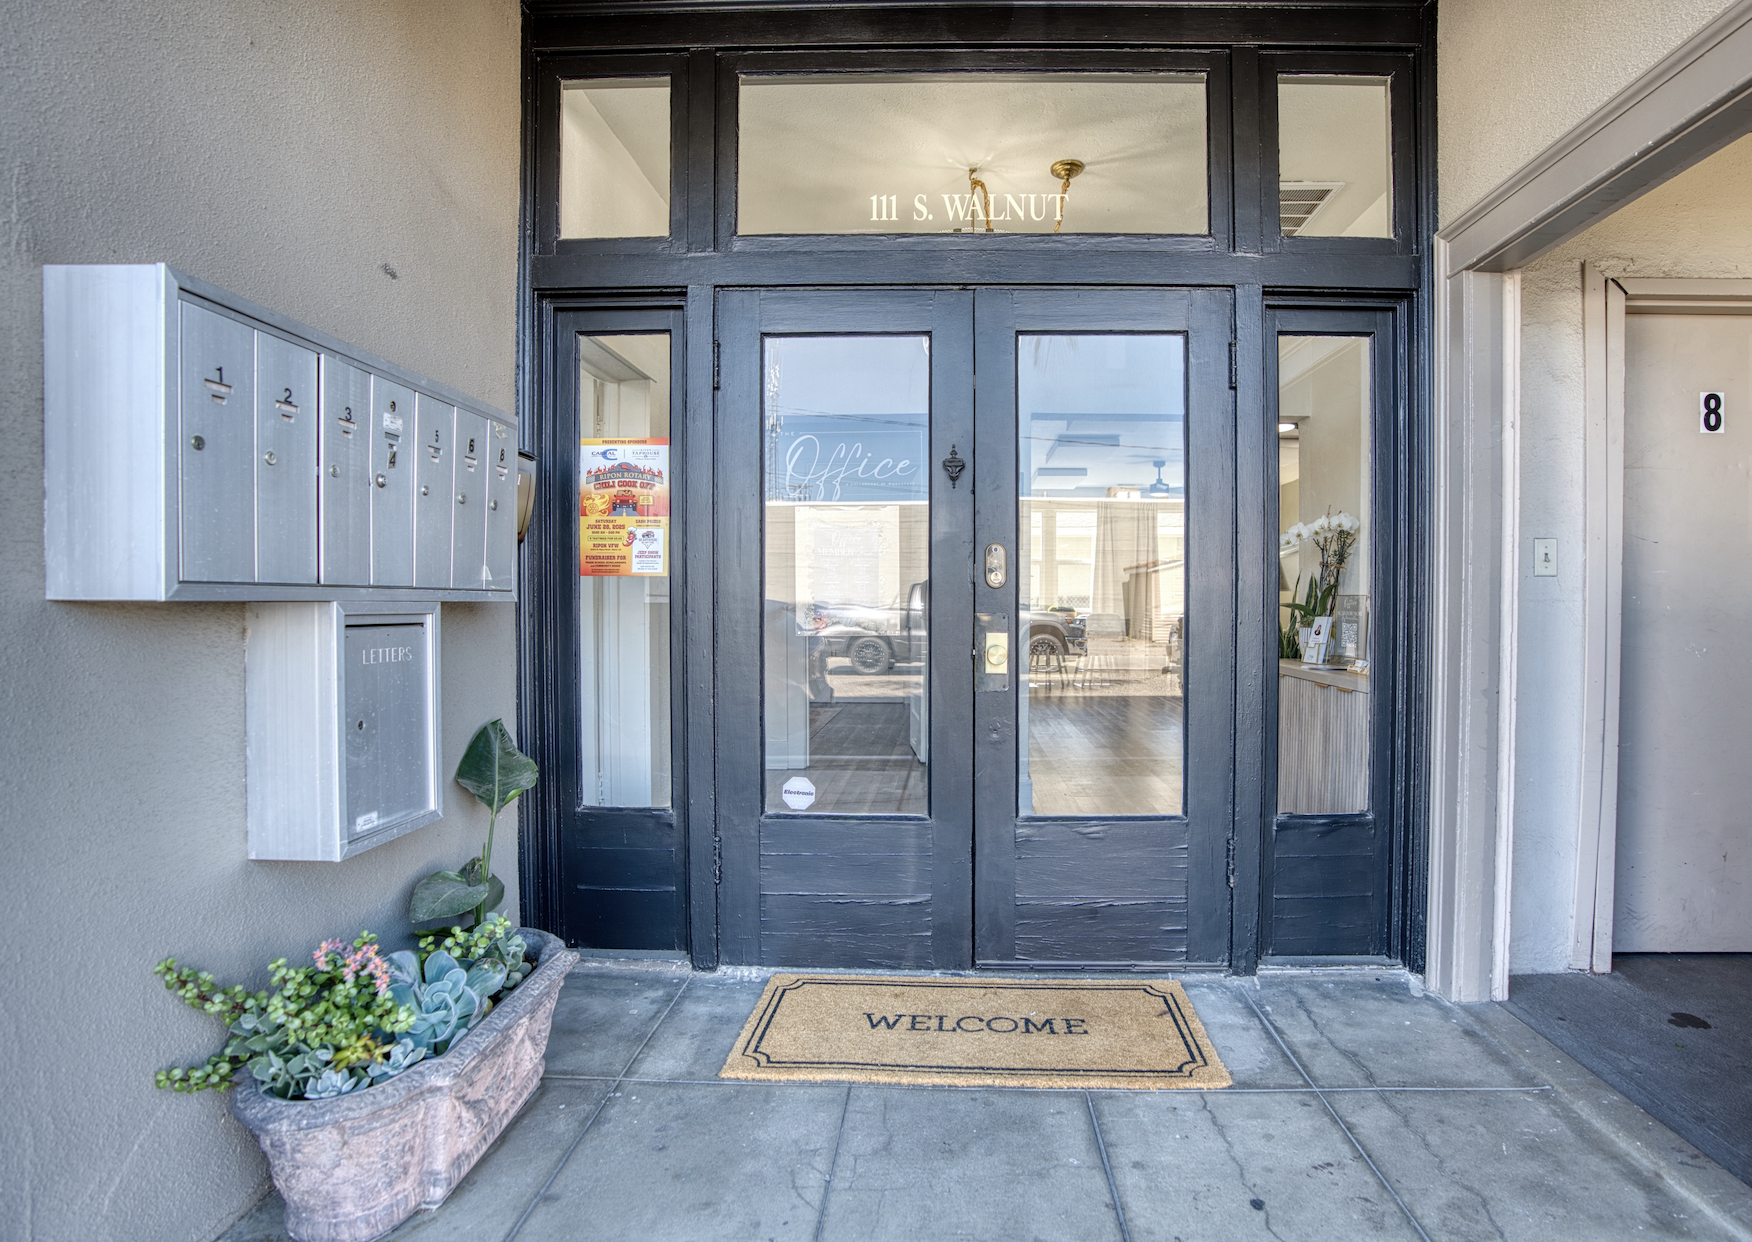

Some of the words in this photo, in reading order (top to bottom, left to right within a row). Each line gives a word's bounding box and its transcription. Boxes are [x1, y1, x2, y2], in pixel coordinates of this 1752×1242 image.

[870, 194, 899, 221] 111
[913, 193, 933, 221] S.
[941, 193, 1070, 221] WALNUT
[216, 366, 223, 382] 1
[283, 388, 293, 403] 2
[344, 407, 353, 421] 3
[1703, 393, 1722, 432] 8
[434, 430, 439, 443] 5
[468, 439, 475, 452] 6
[389, 451, 396, 466] 4
[500, 449, 506, 462] 8
[786, 434, 917, 501] Office
[600, 472, 622, 480] RIPON
[624, 472, 652, 480] ROTARY
[594, 481, 616, 490] CHILI
[617, 480, 638, 488] COOK
[639, 482, 656, 490] OFF
[362, 646, 413, 665] LETTERS
[862, 1012, 1089, 1035] WELCOME
